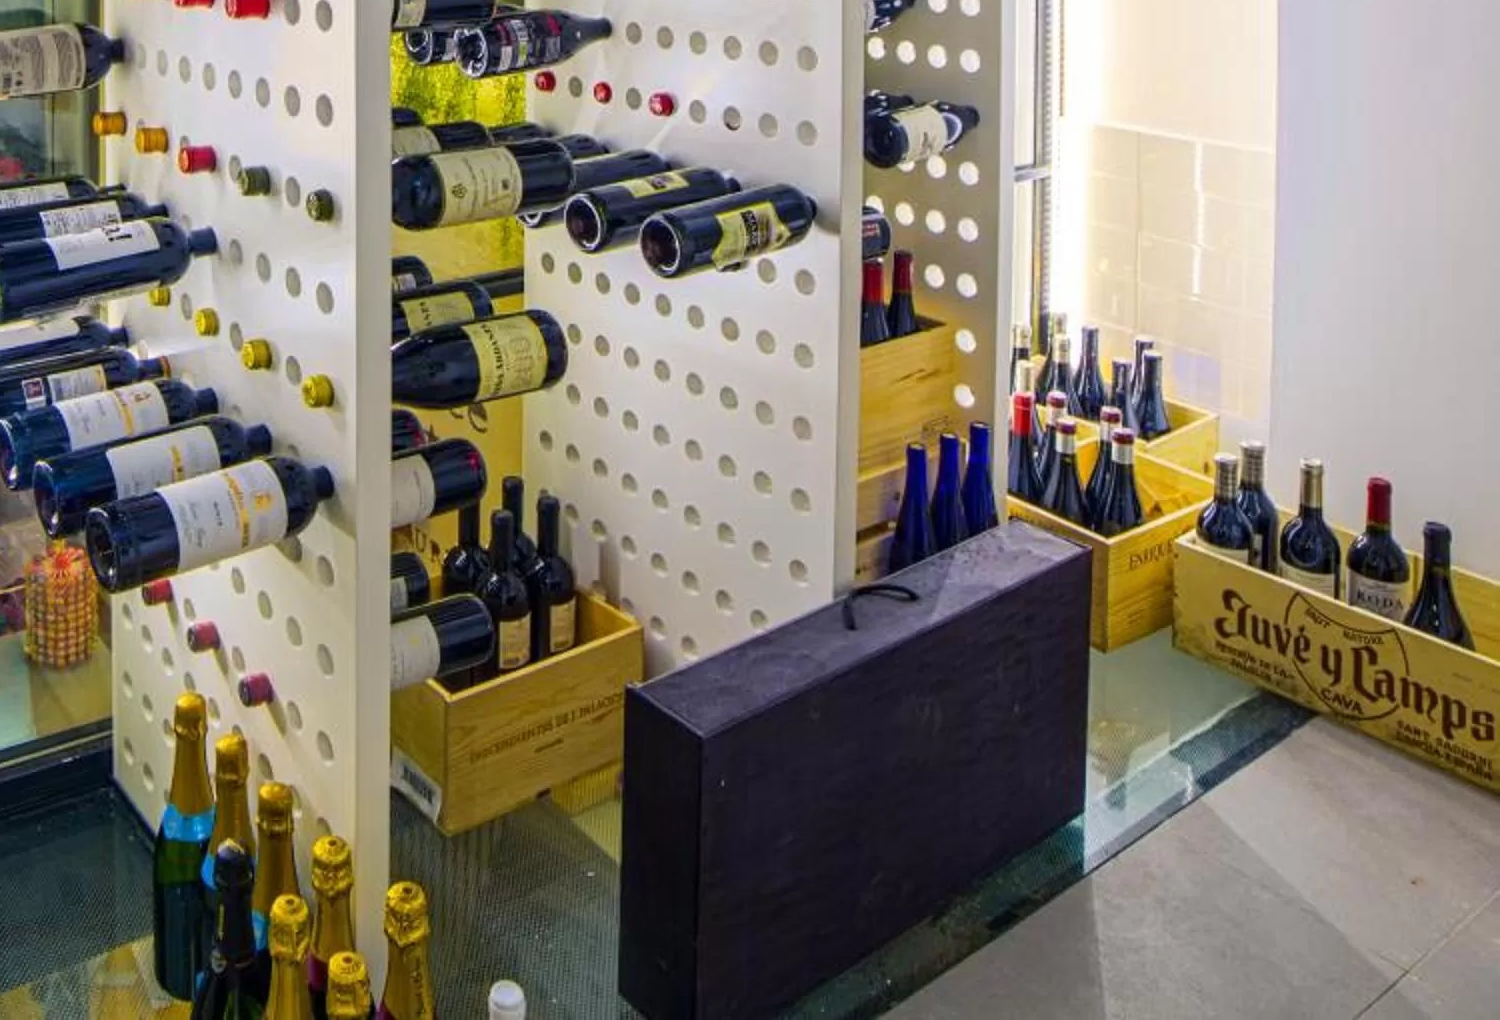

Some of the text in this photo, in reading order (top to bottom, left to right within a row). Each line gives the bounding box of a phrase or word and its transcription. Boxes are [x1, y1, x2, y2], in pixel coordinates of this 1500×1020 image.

[1214, 588, 1495, 742] Juvé y Camps
[1320, 687, 1364, 715] CAVA
